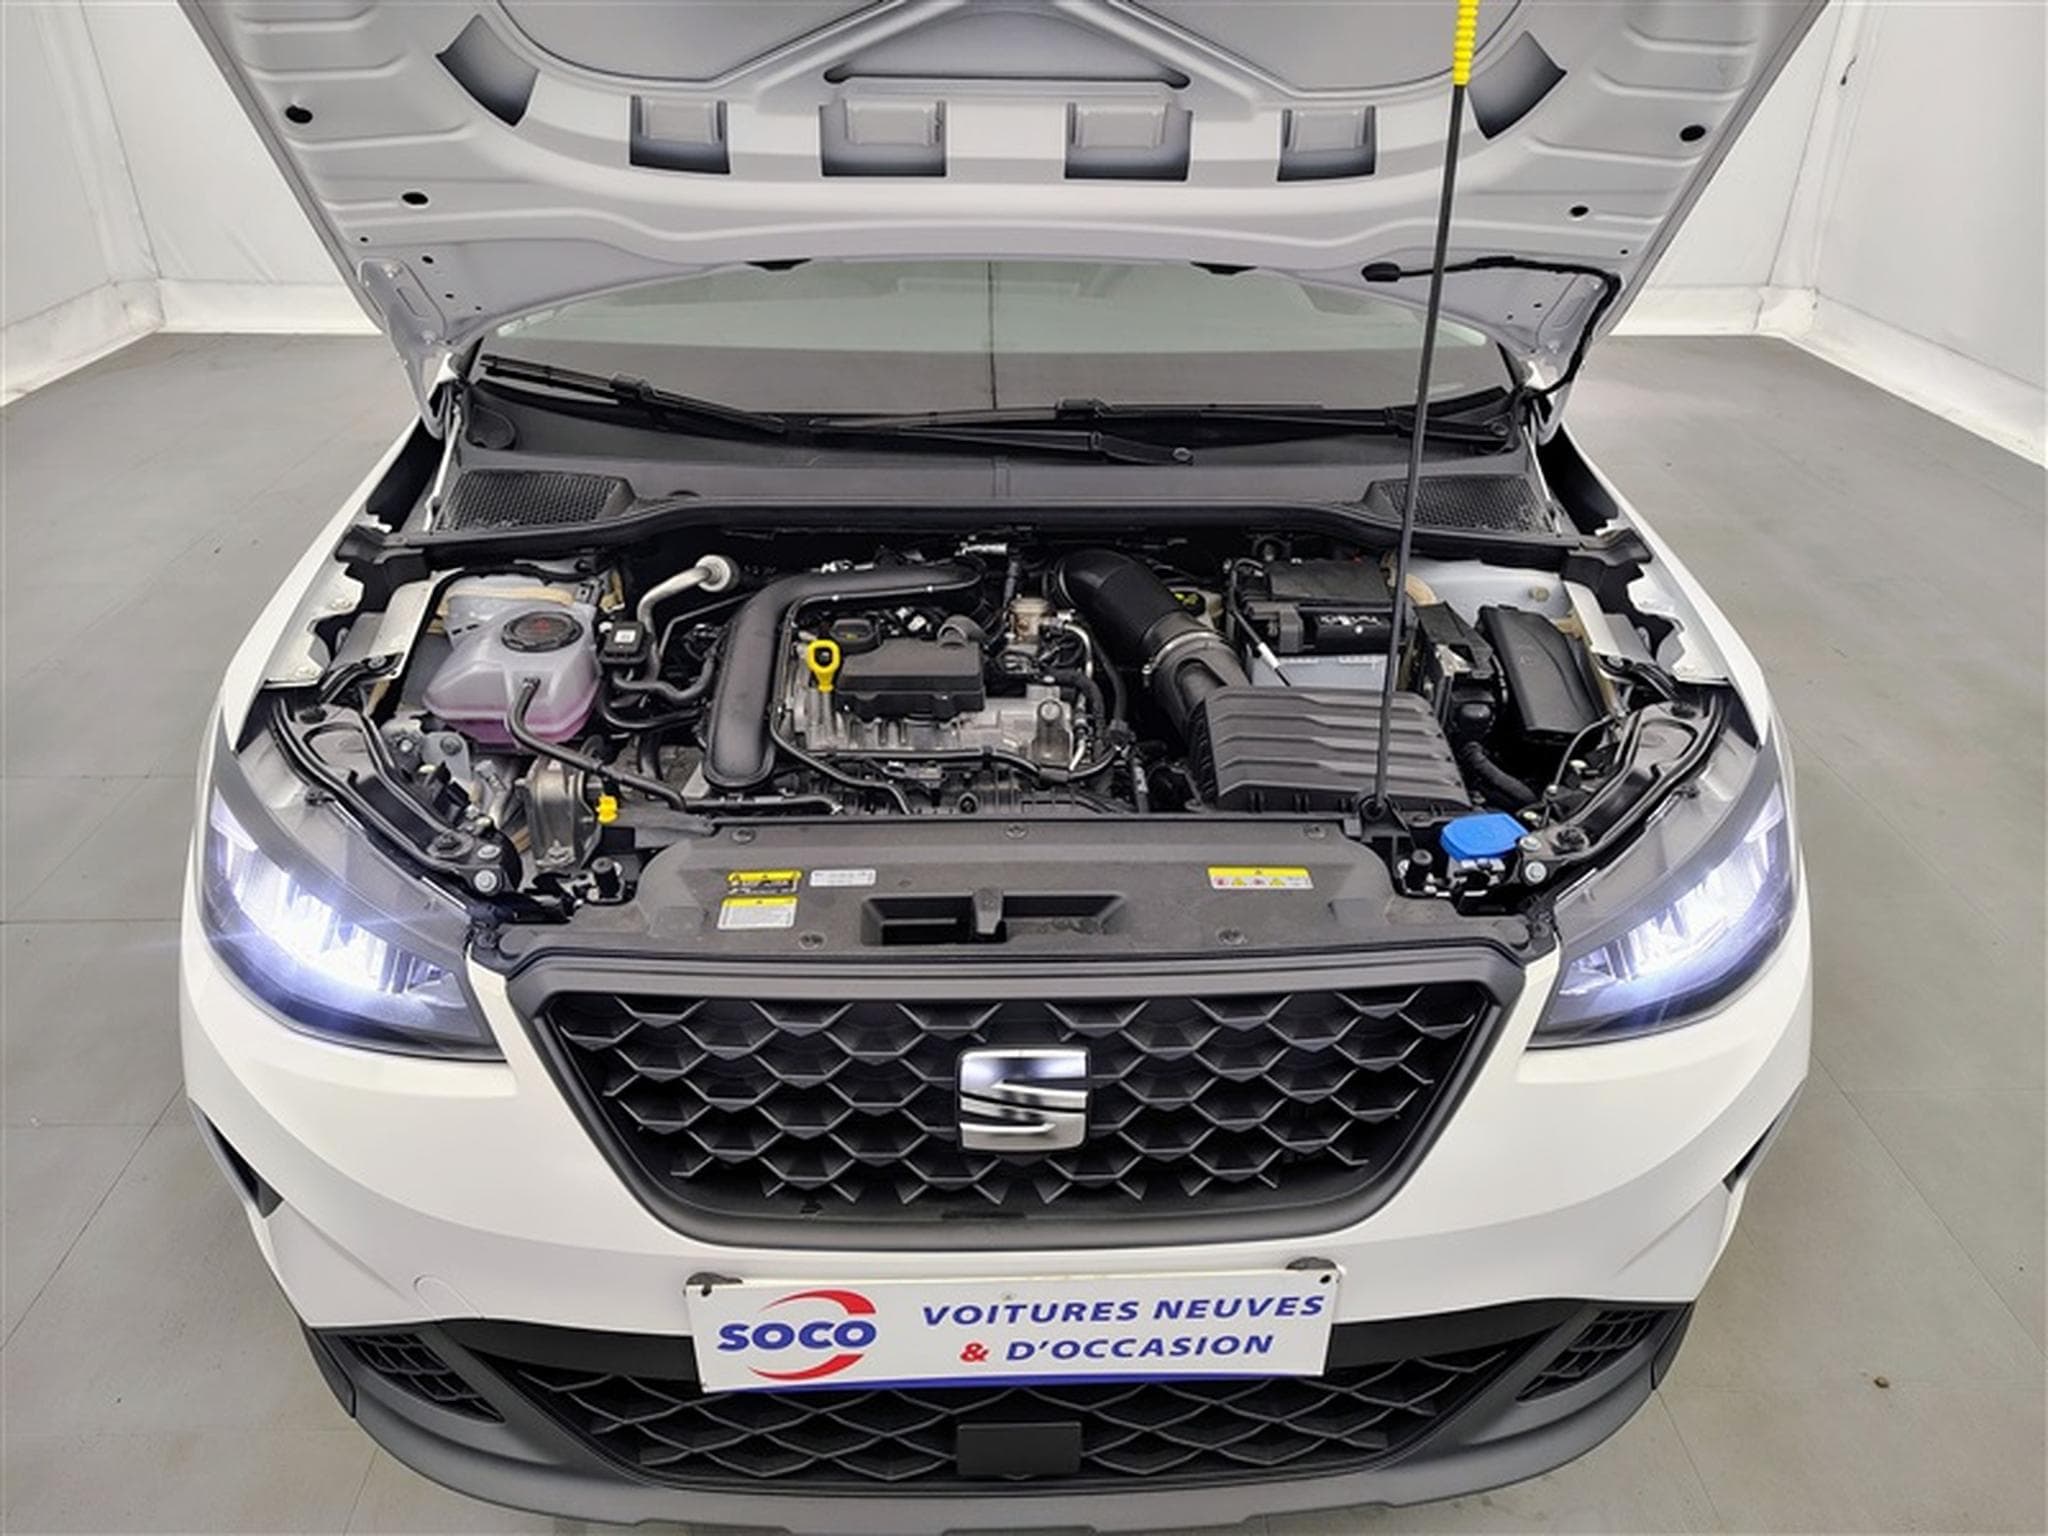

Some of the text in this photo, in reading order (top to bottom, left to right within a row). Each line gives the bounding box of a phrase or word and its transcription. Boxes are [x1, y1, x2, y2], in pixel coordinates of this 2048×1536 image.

[922, 1295, 1325, 1326] VOITURES NEUVES
[717, 1320, 878, 1352] SOCO
[960, 1335, 1274, 1363] & D'OCCASION
